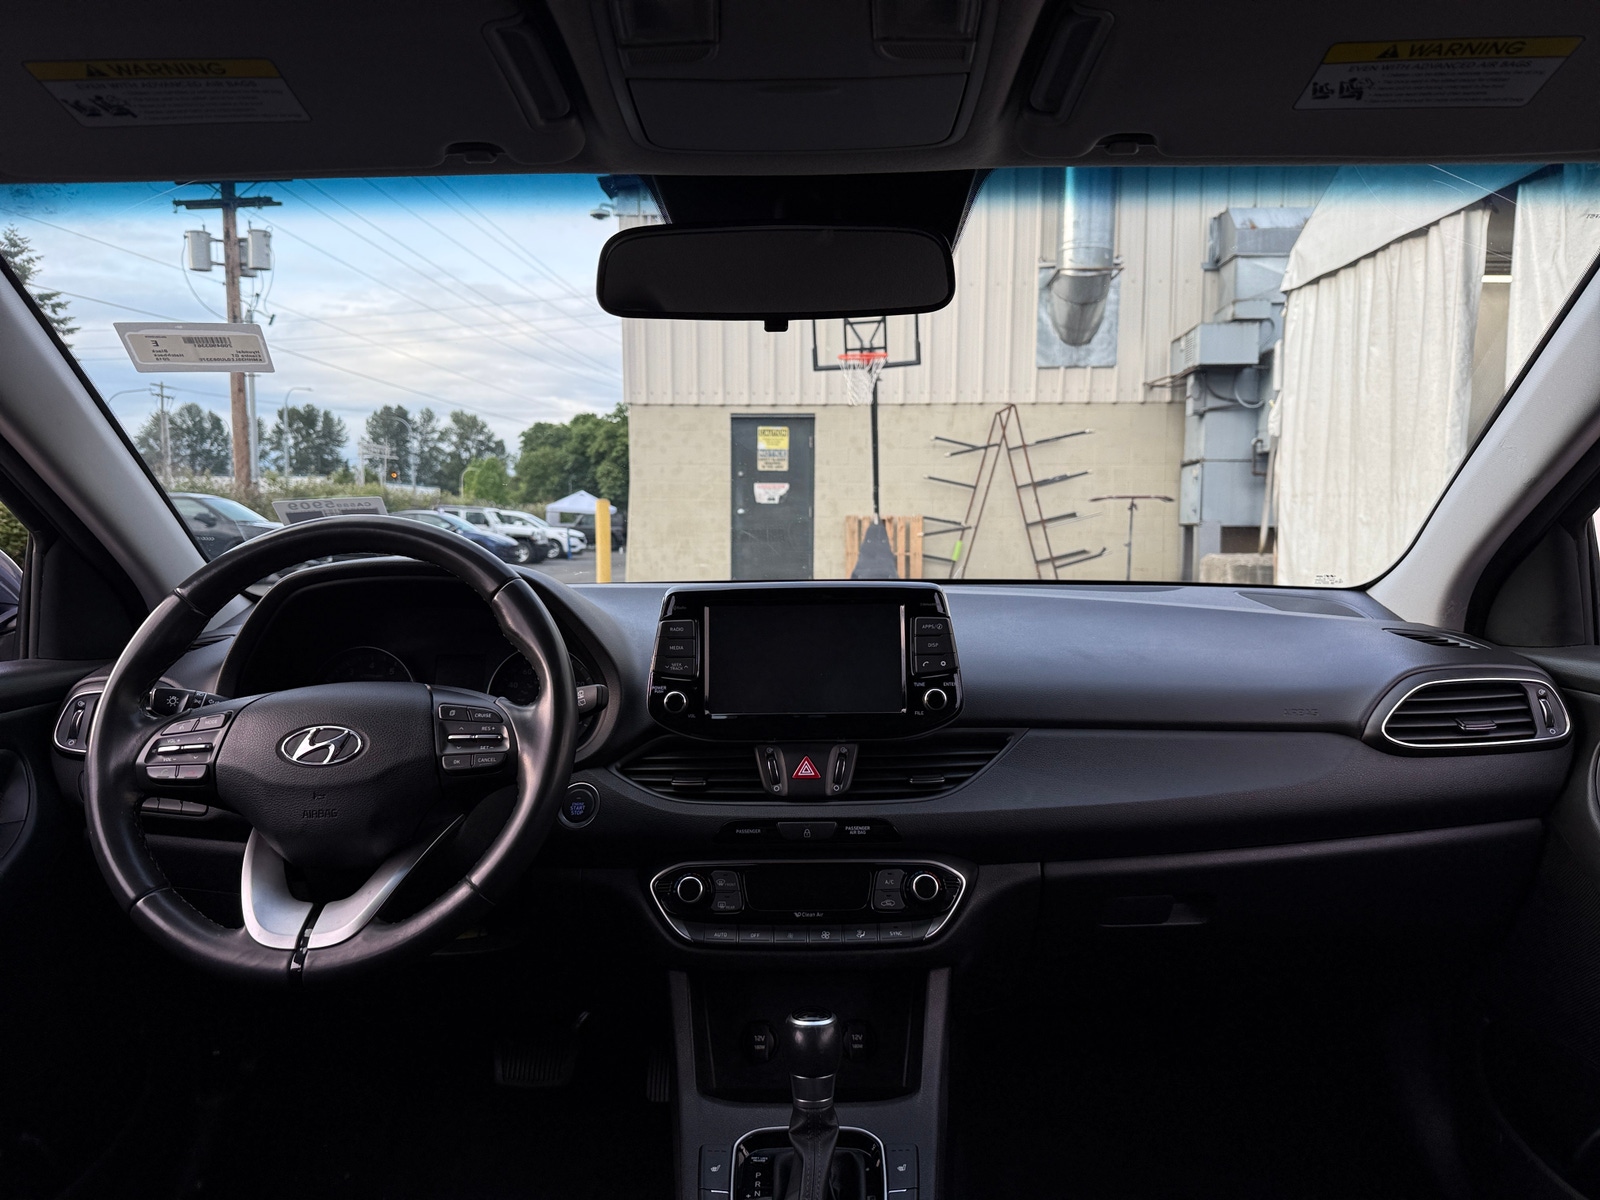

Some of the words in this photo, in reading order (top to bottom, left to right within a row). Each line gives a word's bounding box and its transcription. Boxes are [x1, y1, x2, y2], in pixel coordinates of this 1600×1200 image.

[1407, 41, 1527, 57] WARNING
[105, 61, 226, 77] WARNING
[1347, 65, 1378, 73] EVEN
[1381, 63, 1410, 72] WITH
[1411, 61, 1475, 71] ADVANCED
[1478, 60, 1497, 69] AIR
[1500, 59, 1532, 69] BAGS
[108, 81, 138, 89] WITH
[141, 80, 202, 89] ADVANCED
[302, 808, 338, 818] AIRBAG
[884, 878, 895, 886] A/C
